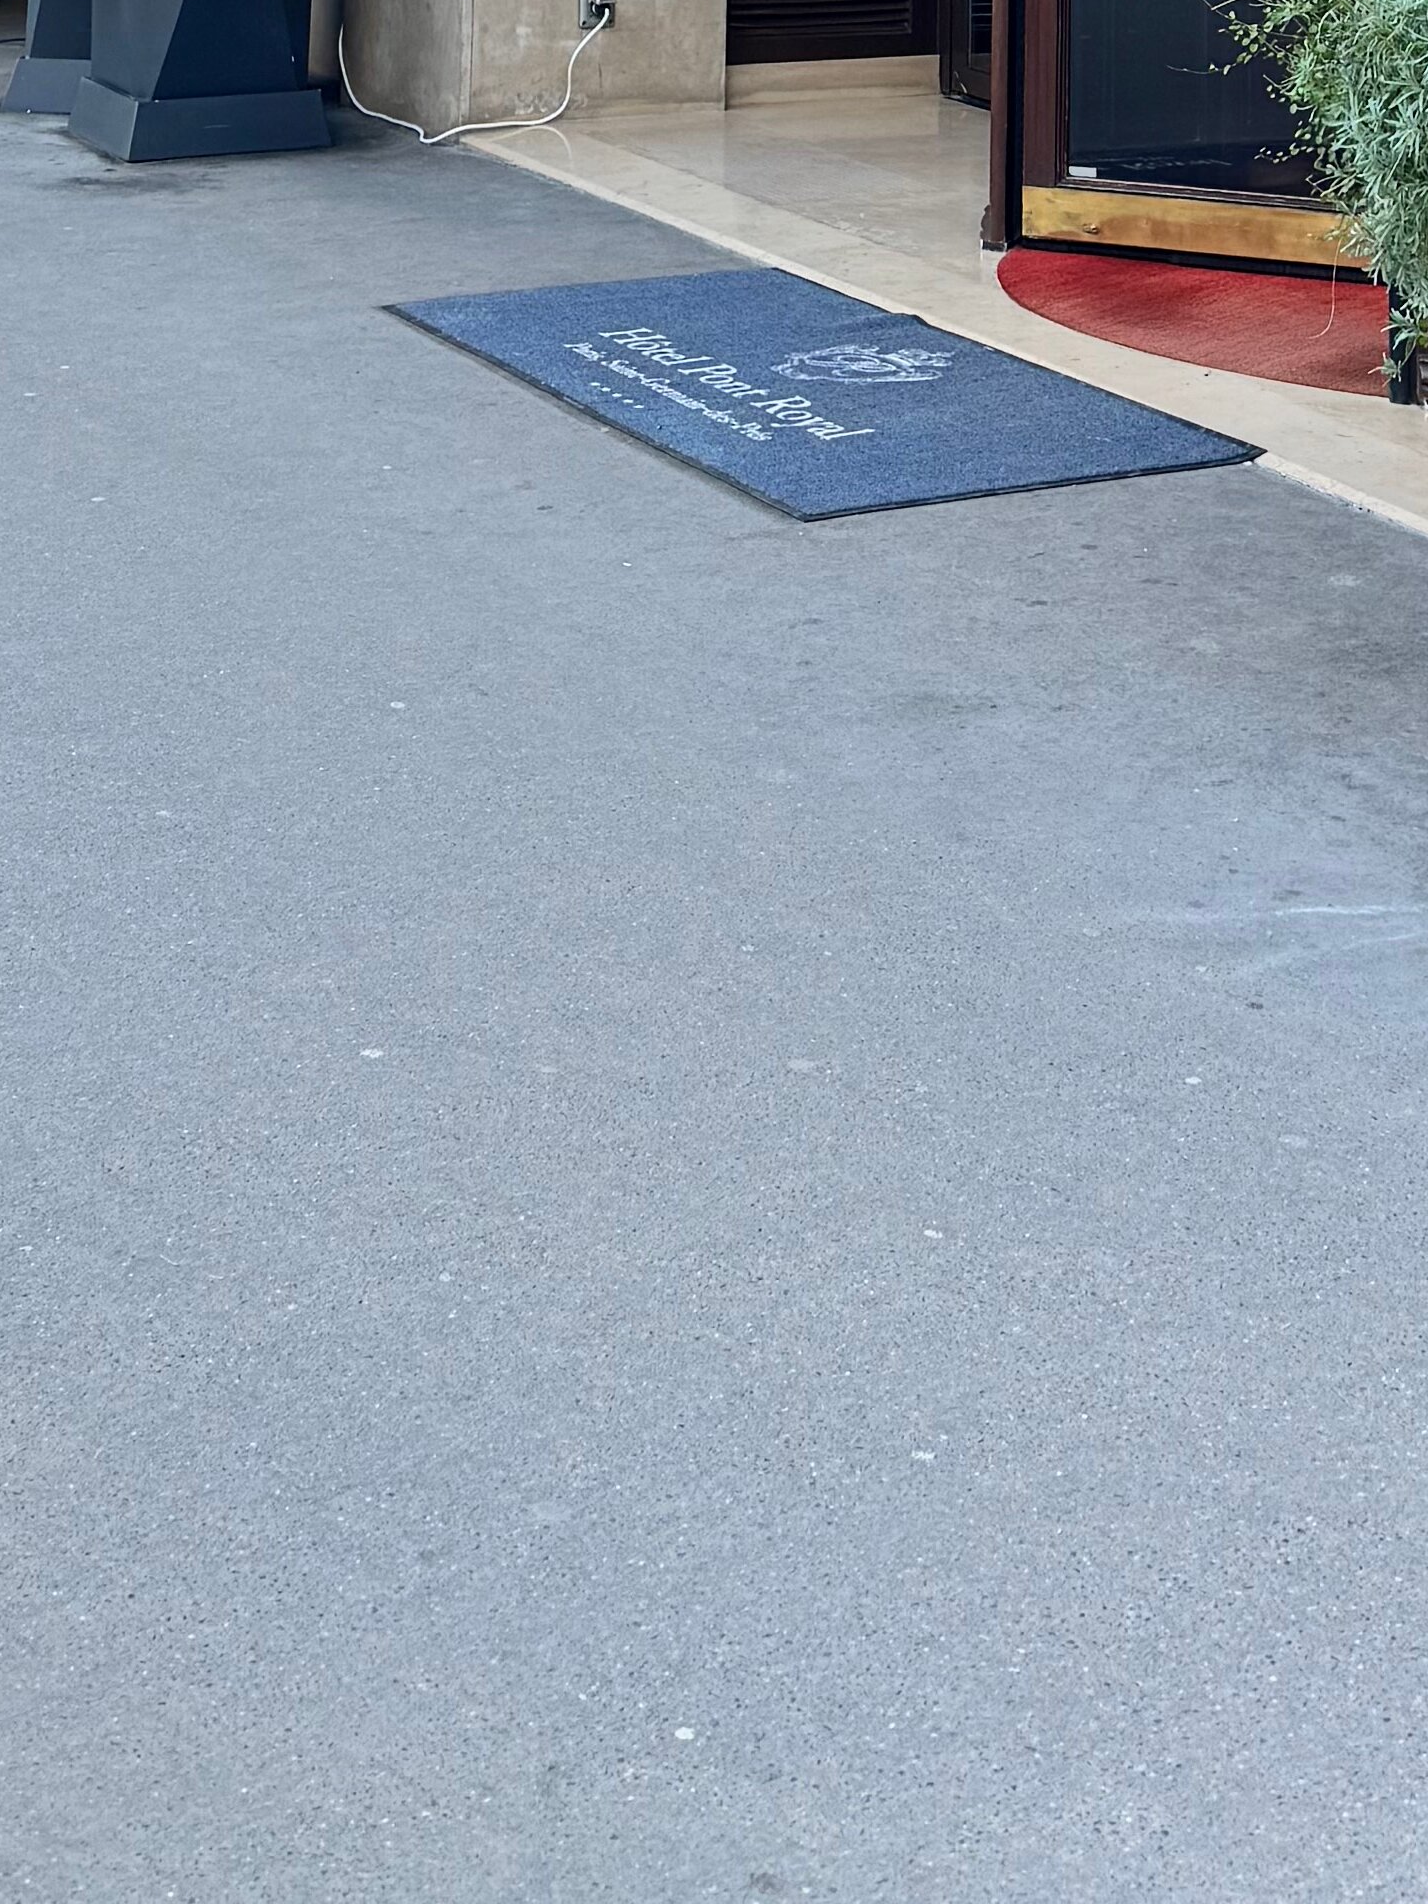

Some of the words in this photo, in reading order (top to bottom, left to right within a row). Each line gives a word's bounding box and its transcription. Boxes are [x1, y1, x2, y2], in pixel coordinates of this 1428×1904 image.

[598, 327, 714, 366] Hôtel
[677, 363, 770, 398] Pont
[749, 395, 876, 440] Royal
